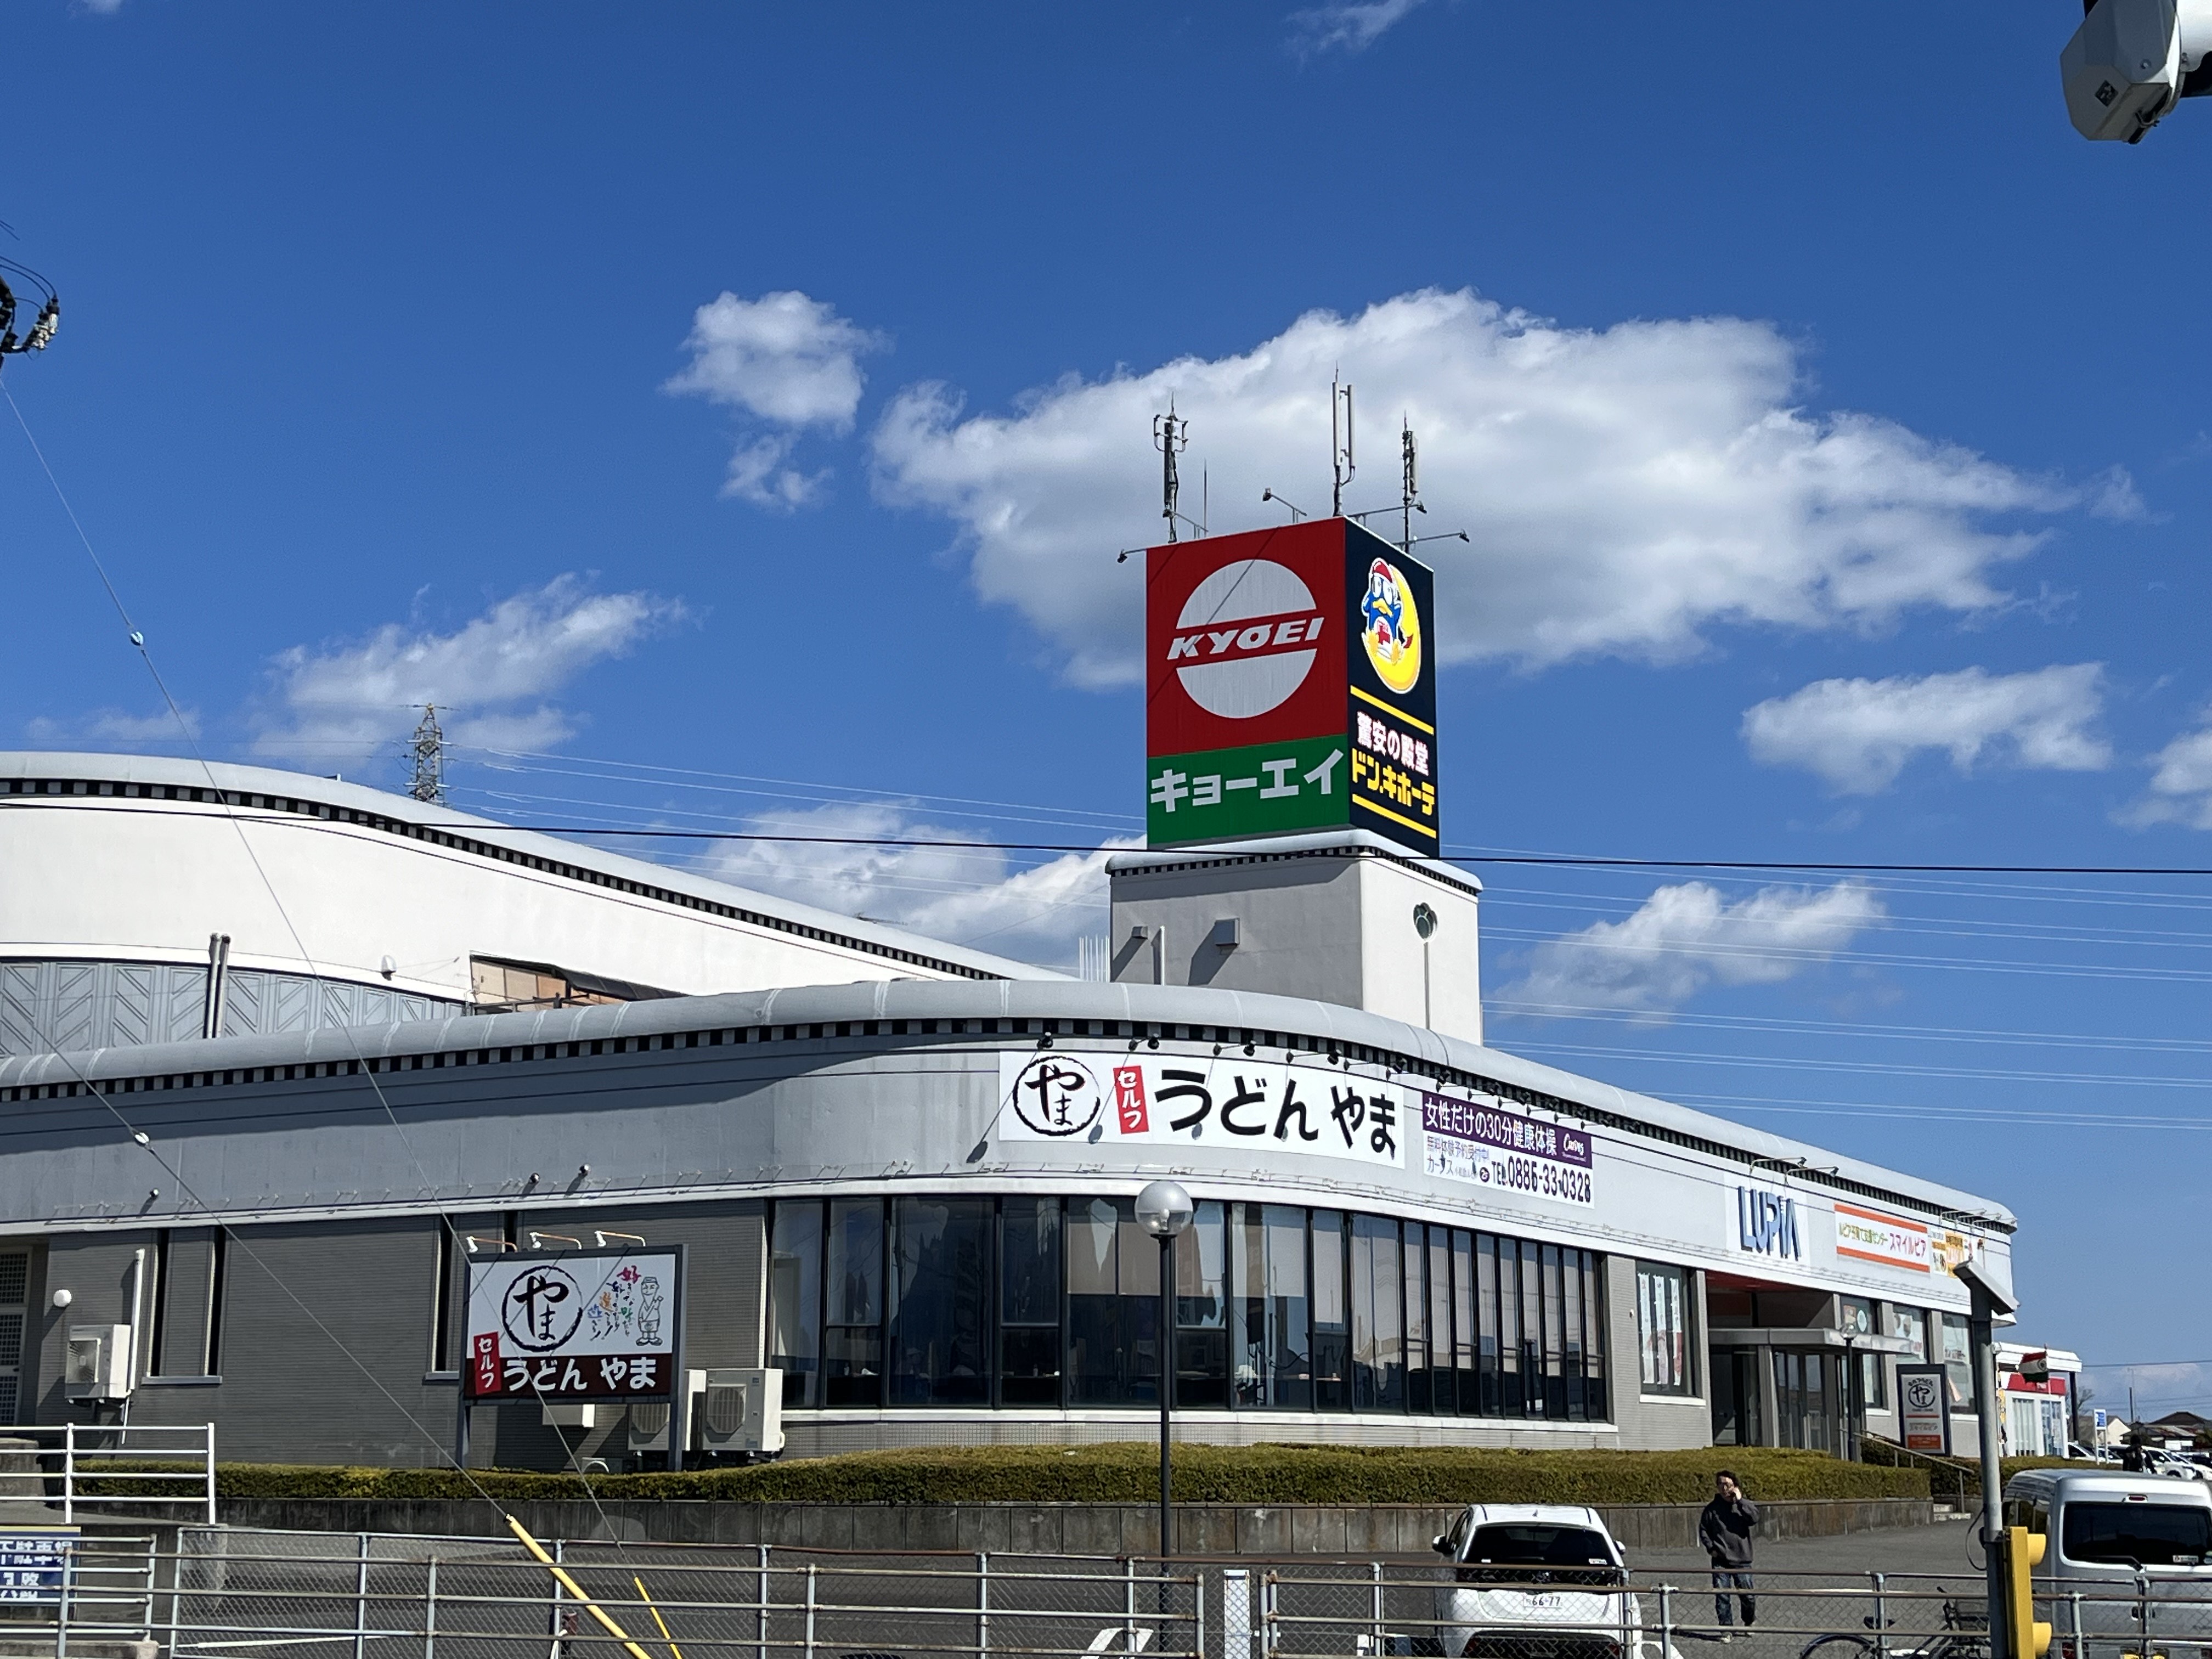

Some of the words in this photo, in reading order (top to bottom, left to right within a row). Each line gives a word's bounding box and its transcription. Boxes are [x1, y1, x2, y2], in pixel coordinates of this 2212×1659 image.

[1167, 617, 1324, 660] KYOEI
[1150, 748, 1344, 812] キョーエイ
[1024, 1064, 1085, 1126] やま
[1118, 1070, 1142, 1129] セルフ
[1154, 1069, 1319, 1141] うどん
[1331, 1086, 1396, 1160] やま
[513, 1275, 569, 1341] やま
[478, 1338, 495, 1389] セルフ
[504, 1358, 588, 1391] うどん
[600, 1357, 656, 1390] やま
